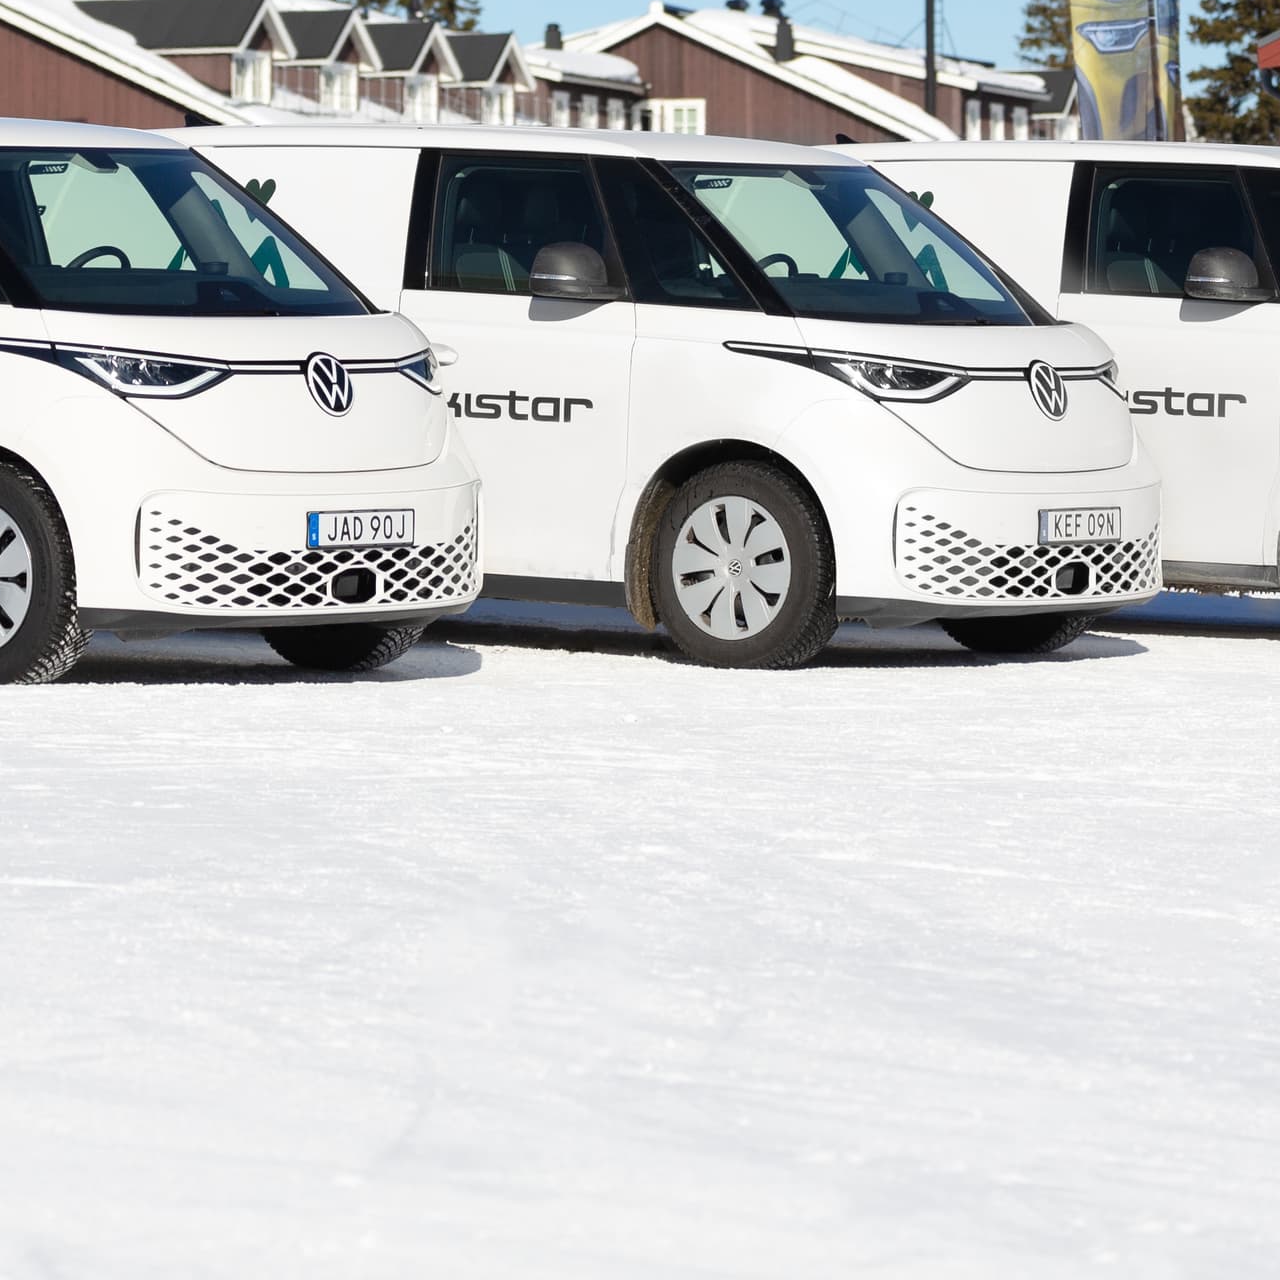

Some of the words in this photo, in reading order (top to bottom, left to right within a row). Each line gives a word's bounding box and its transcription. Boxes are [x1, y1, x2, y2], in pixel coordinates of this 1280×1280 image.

[310, 356, 349, 412] VW
[1032, 364, 1066, 417] VW
[446, 390, 594, 423] kistar
[327, 515, 364, 542] JAD
[370, 514, 406, 540] 90J
[1054, 513, 1082, 538] KEF
[1087, 512, 1115, 537] 09N
